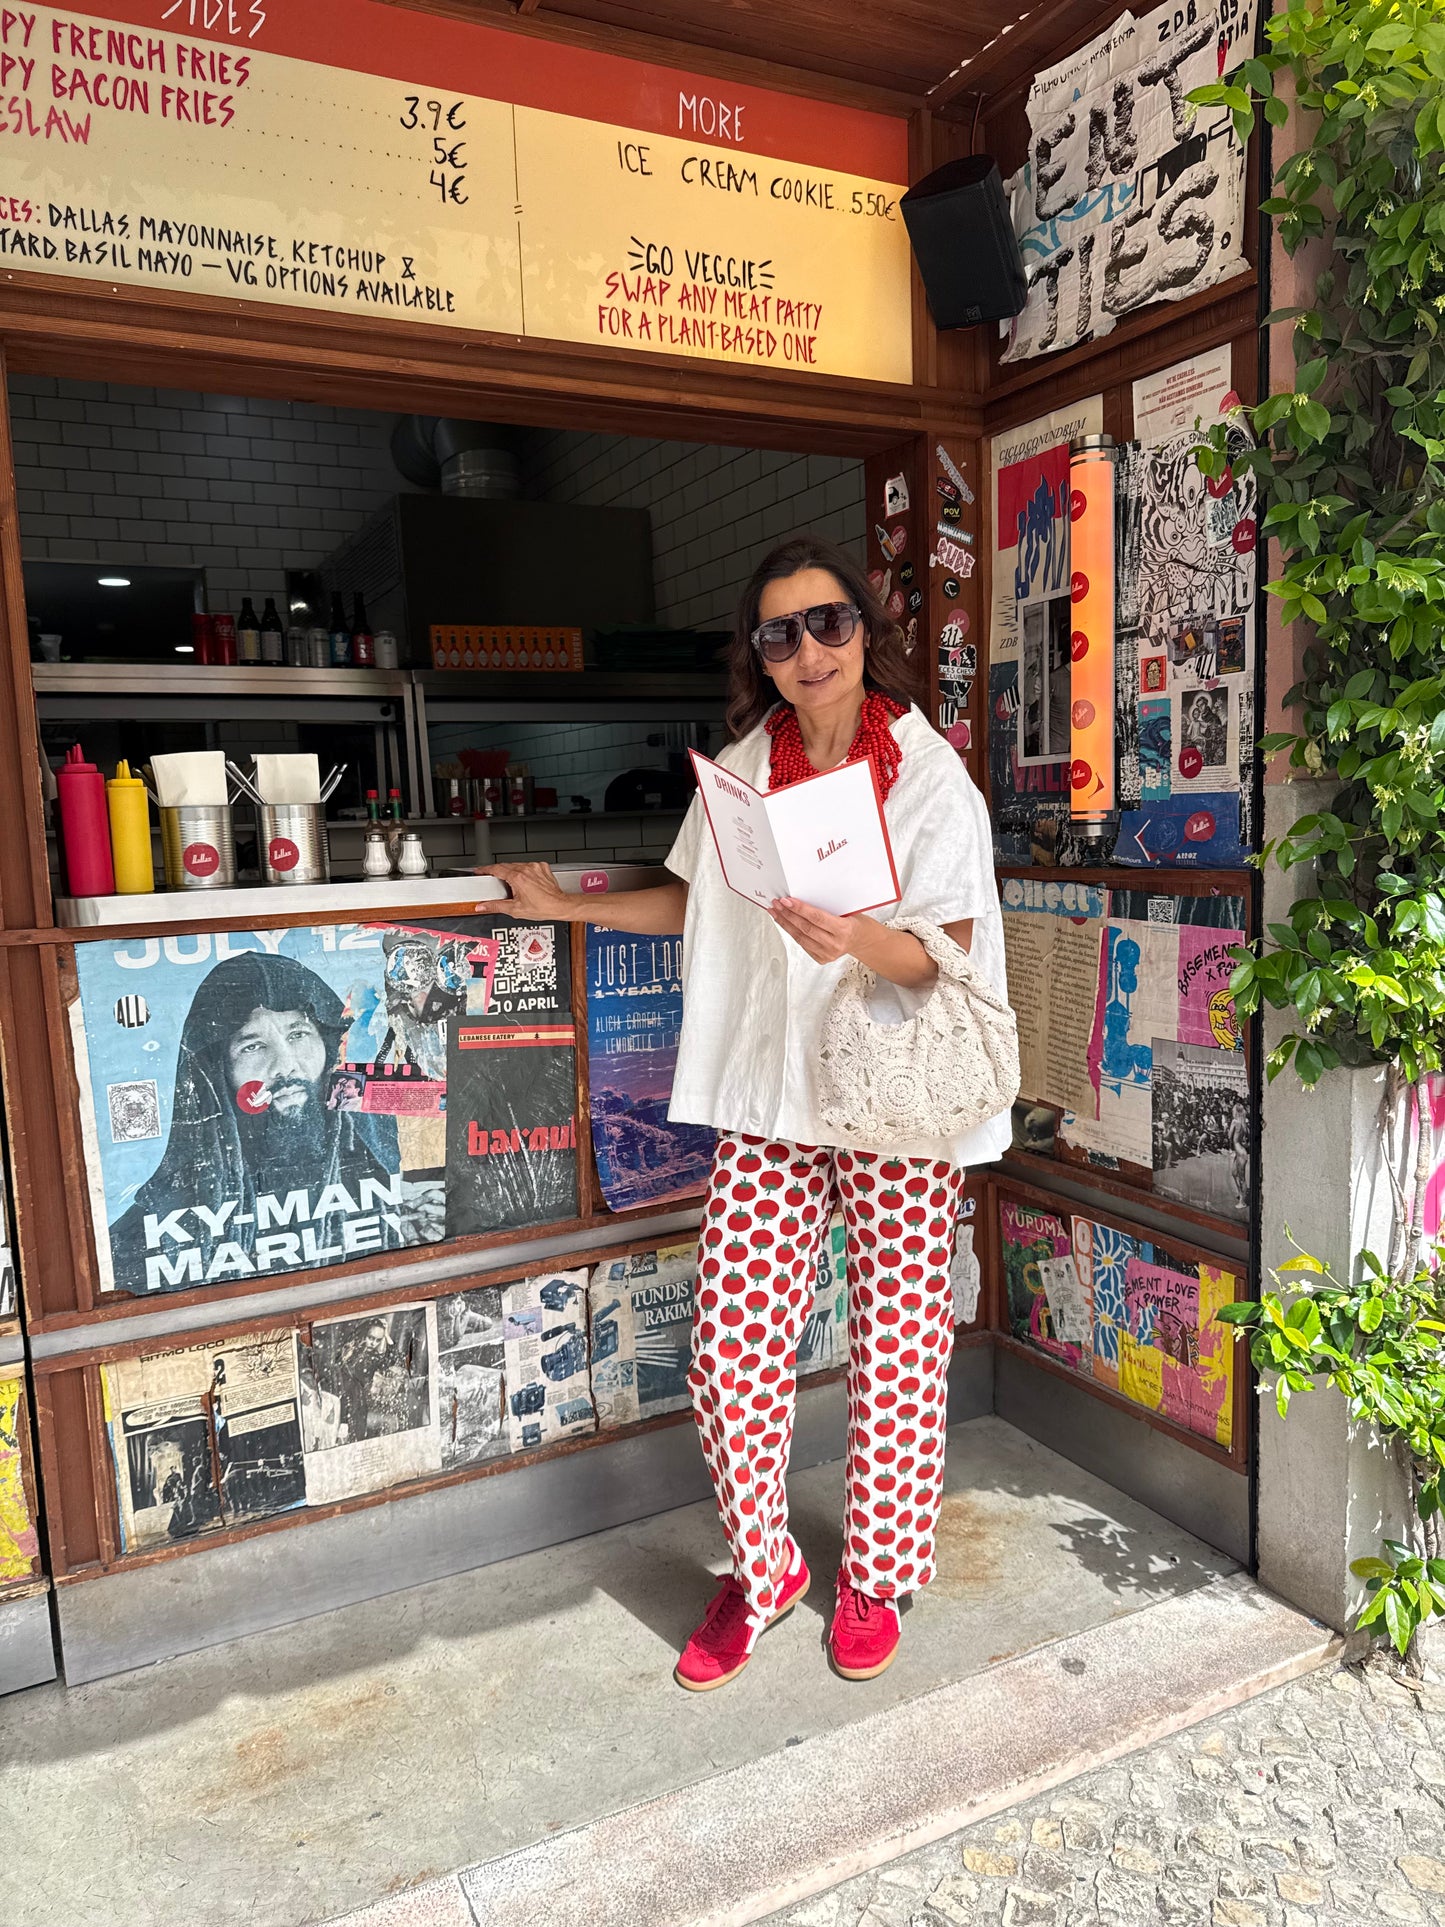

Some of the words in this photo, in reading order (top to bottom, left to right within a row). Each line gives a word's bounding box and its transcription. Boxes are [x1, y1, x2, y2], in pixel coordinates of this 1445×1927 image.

[1158, 0, 1197, 42] ZDB
[53, 19, 166, 73] FRENCH
[176, 43, 251, 87] FRIES
[399, 97, 466, 130] 3.9€
[52, 63, 149, 114] BACON
[162, 85, 236, 127] FRIES
[433, 137, 468, 169] 5€
[678, 91, 746, 141] MORE
[617, 141, 653, 176] ICE
[681, 156, 758, 197] CREAM
[430, 170, 468, 205] 4€
[49, 203, 130, 240] DALLAS,
[140, 215, 284, 262] MAYONNAISE,
[292, 240, 386, 274] KETCHUP
[66, 238, 132, 269] BASIL
[138, 247, 192, 276] MAYO
[227, 258, 257, 285] VG
[266, 264, 348, 298] OPTIONS
[356, 278, 455, 313] AVAILABLE
[645, 243, 673, 277] GO
[685, 250, 757, 290] VEGGIE
[605, 272, 671, 307] SWAP
[678, 282, 717, 315] ANY
[724, 292, 771, 323] MEAT
[776, 299, 822, 331] PATTY
[598, 305, 633, 338] FOR
[637, 315, 652, 342] A
[658, 314, 777, 359] PLANT-BASED
[783, 334, 818, 364] ONE
[1000, 441, 1026, 461] CICLO
[1026, 417, 1087, 451] CONUNDRUM
[943, 507, 960, 515] POV
[901, 567, 913, 578] POV
[937, 539, 974, 577] RUDE
[571, 632, 581, 669] TABASCO
[1000, 636, 1018, 649] ZDB
[956, 668, 976, 676] CHESS
[713, 774, 751, 807] DRINKS
[816, 837, 848, 863] Dallas
[114, 928, 289, 969] JULY
[311, 923, 380, 951] 12
[595, 943, 637, 986] JUST
[651, 940, 684, 982] LOO
[516, 996, 558, 1012] APRIL
[595, 984, 662, 998] 1-YEAR
[459, 1034, 491, 1042] LEBANESE
[596, 1015, 621, 1033] ALICIA
[626, 1011, 662, 1030] CARRERA
[143, 1174, 403, 1249] KY-MAN
[632, 1280, 689, 1308] TUNDJS
[1124, 1277, 1161, 1298] EMENT
[1167, 1280, 1198, 1299] LOVE
[1143, 1293, 1181, 1315] POWER
[645, 1301, 694, 1327] RAKIM
[140, 1348, 185, 1363] RITMO
[189, 1339, 226, 1353] LOCO
